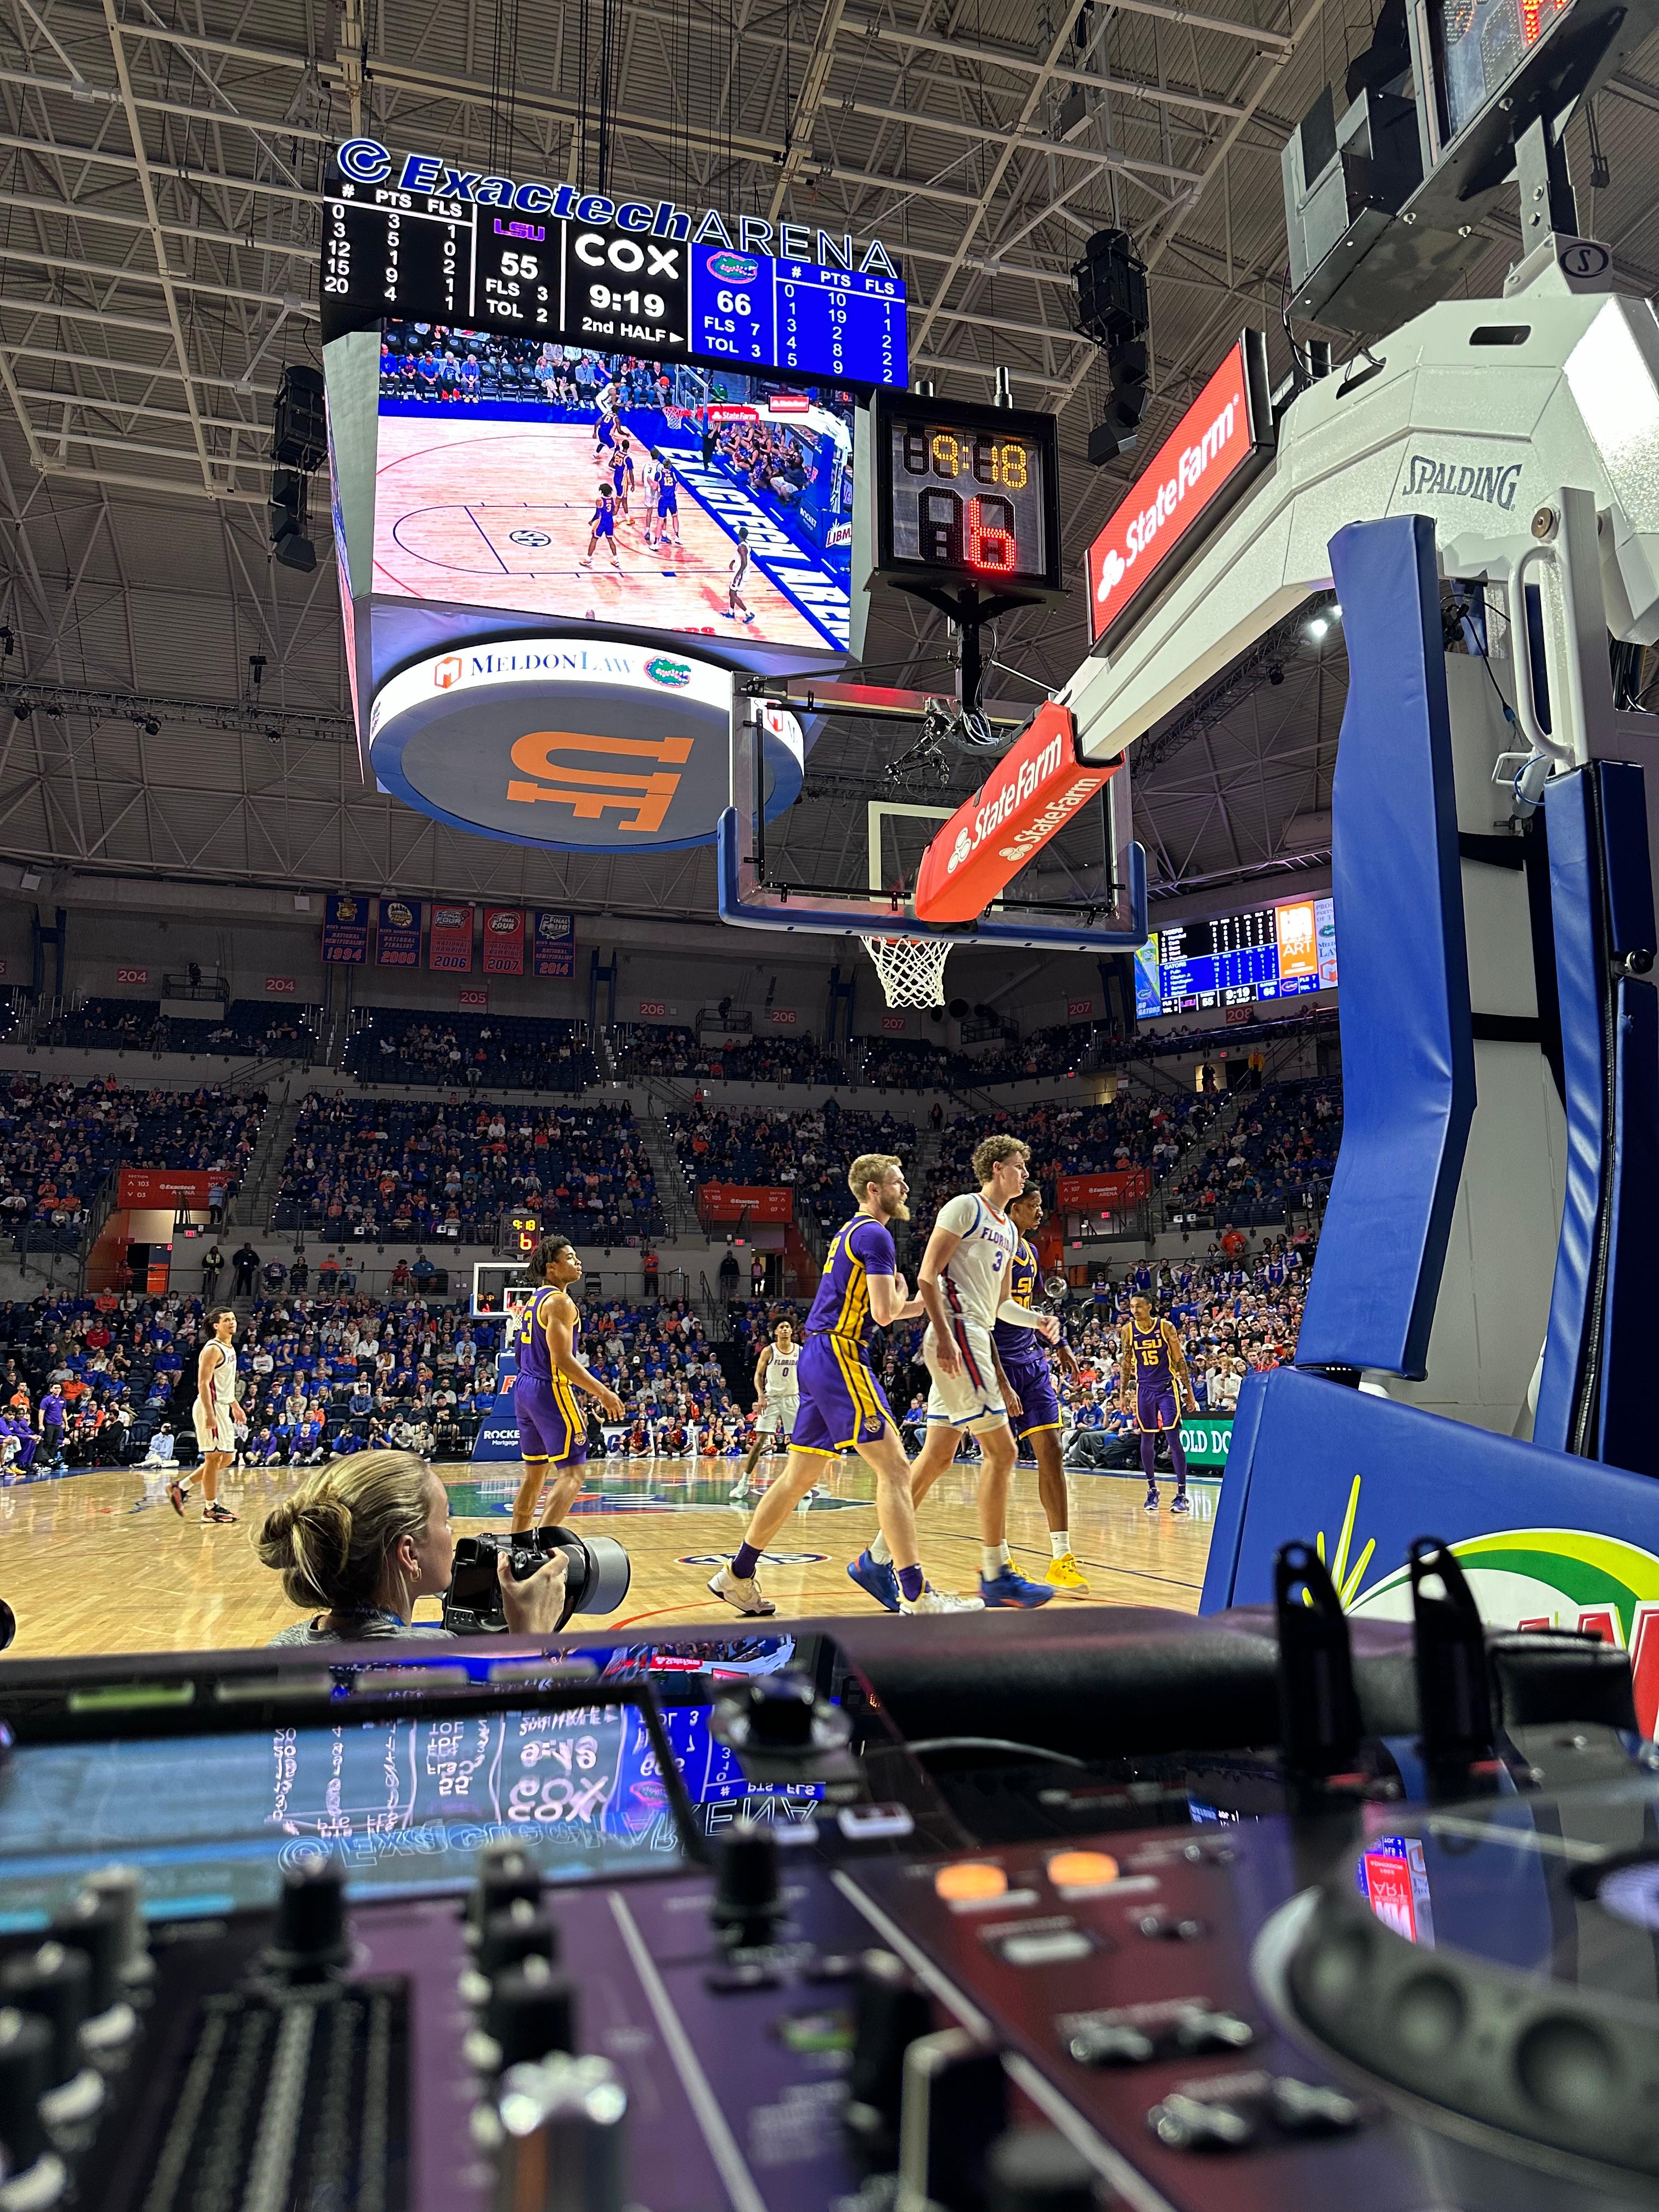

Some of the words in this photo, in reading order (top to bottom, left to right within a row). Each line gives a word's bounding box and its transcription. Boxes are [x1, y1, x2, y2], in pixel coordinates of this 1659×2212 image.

[376, 190, 412, 208] PTS
[428, 200, 462, 217] FLS
[332, 202, 347, 219] 0
[388, 214, 400, 229] 3
[447, 224, 455, 239] 1
[398, 153, 692, 242] Exactech
[693, 209, 898, 279] ARENA
[333, 222, 346, 238] 3
[387, 231, 399, 247] 5
[444, 241, 456, 256] 0
[493, 218, 545, 242] LSU
[328, 240, 351, 257] 12
[390, 250, 398, 266] 1
[443, 259, 455, 275] 2
[500, 252, 539, 280] 55
[574, 233, 679, 280] COX
[328, 258, 349, 275] 15
[386, 267, 398, 283] 9
[445, 278, 454, 292] 1
[820, 270, 851, 287] PTS
[865, 278, 895, 294] FLS
[324, 276, 349, 294] 20
[384, 286, 397, 301] 4
[445, 296, 453, 311] 1
[486, 278, 520, 297] FLS
[537, 286, 548, 301] 3
[785, 284, 794, 298] 0
[828, 292, 847, 307] 10
[883, 302, 890, 315] 1
[486, 298, 524, 318] TOL
[536, 308, 548, 323] 2
[589, 284, 665, 318] 9:19
[716, 290, 752, 316] 66
[704, 315, 736, 332] FLS
[751, 323, 760, 336] 7
[789, 302, 795, 315] 1
[828, 309, 847, 324] 19
[884, 318, 890, 331] 1
[582, 317, 614, 335] 2nd
[620, 323, 667, 342] HALF
[787, 318, 797, 332] 3
[832, 326, 842, 340] 2
[882, 335, 891, 349] 2
[704, 336, 739, 353] TOL
[751, 344, 761, 358] 3
[786, 336, 797, 349] 4
[833, 343, 843, 357] 8
[882, 352, 892, 366] 2
[787, 353, 797, 366] 5
[833, 360, 843, 374] 9
[883, 369, 893, 383] 2
[932, 434, 1028, 489] 9:18
[1402, 454, 1523, 511] SPALDING
[506, 731, 695, 832] UF
[492, 922, 515, 930] FOUR
[541, 922, 568, 931] FOUR
[326, 947, 363, 961] 1994
[380, 951, 416, 964] 2000
[1282, 940, 1313, 957] ART
[434, 956, 467, 969] 2006
[487, 959, 520, 971] 2007
[539, 962, 569, 975] 2014
[118, 970, 148, 983] 204
[267, 979, 295, 991] 204
[460, 992, 487, 1003] 205
[1202, 997, 1214, 1007] 55
[1226, 986, 1250, 1000] 9:19
[640, 1004, 664, 1015] 206
[773, 1012, 795, 1023] 206
[1069, 1001, 1091, 1015] 207
[1138, 1006, 1160, 1015] GATORS
[883, 1019, 905, 1029] 207
[512, 1220, 536, 1231] 9:18
[992, 1251, 1003, 1272] 3
[1133, 1339, 1163, 1351] LSU
[1141, 1350, 1160, 1366] 15
[782, 1367, 789, 1377] 0
[499, 1374, 517, 1395] F
